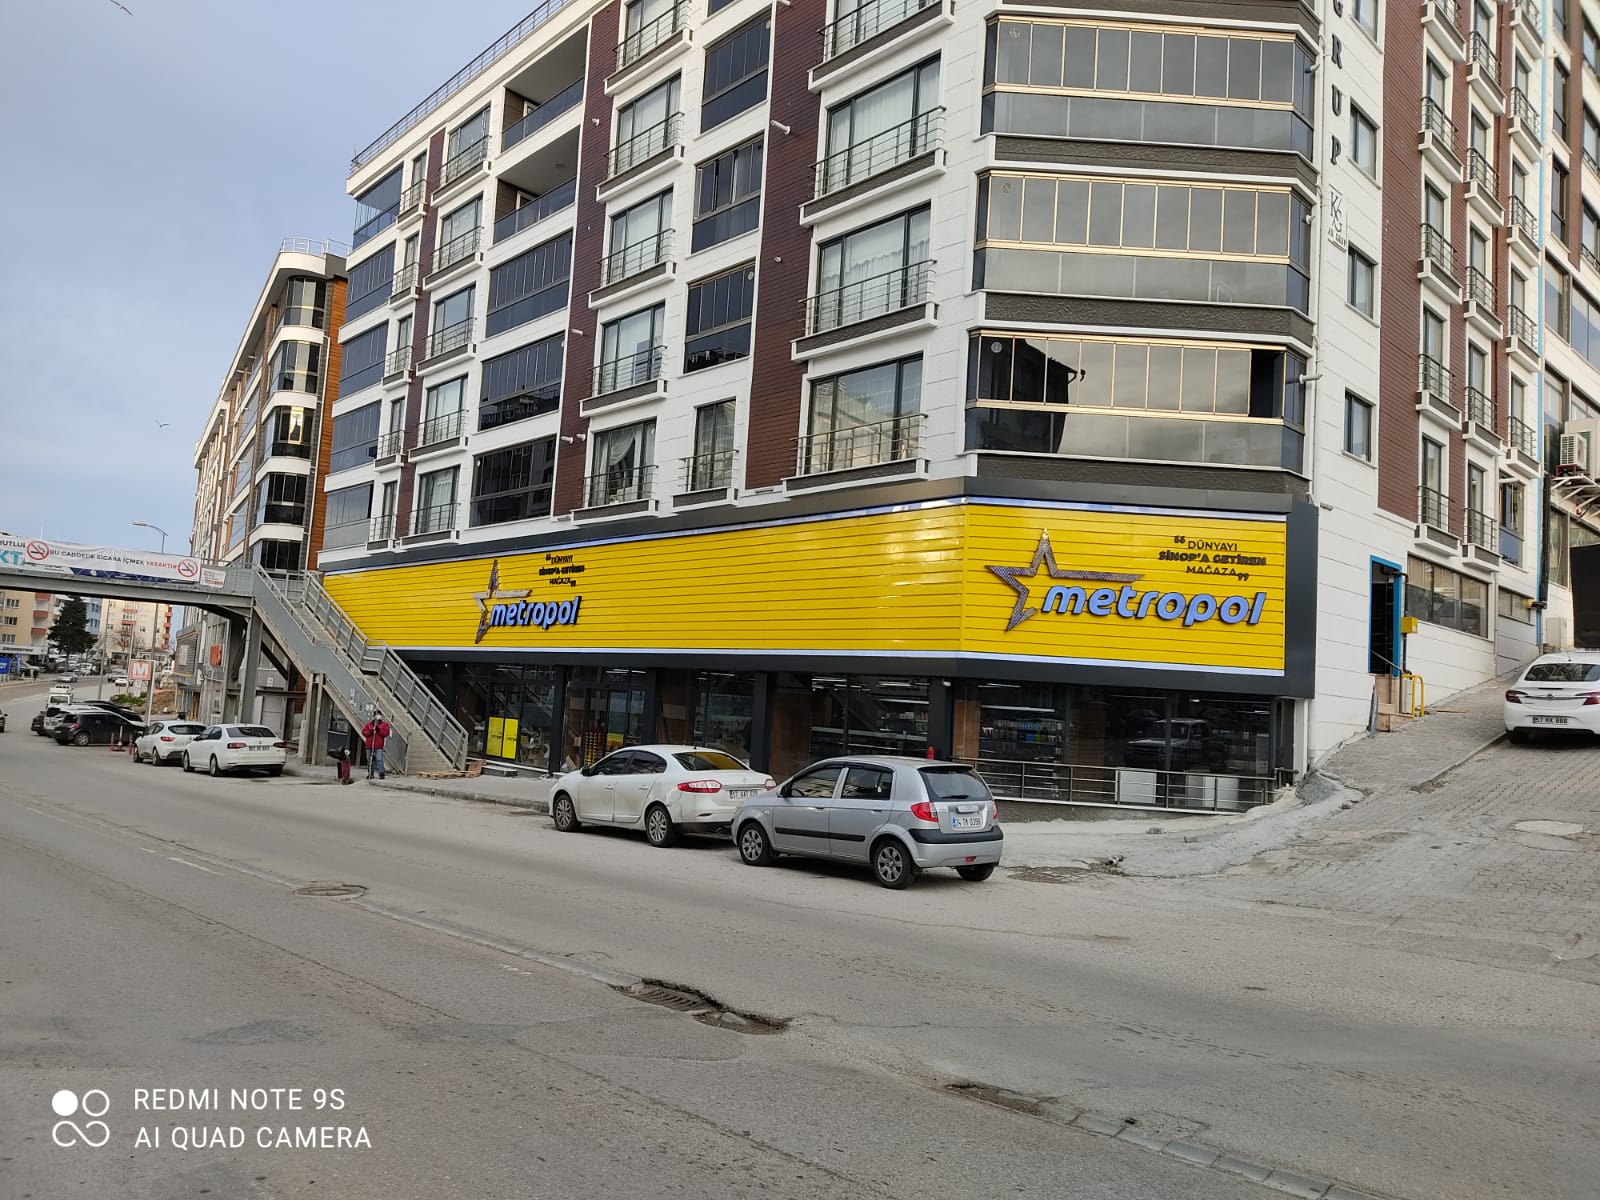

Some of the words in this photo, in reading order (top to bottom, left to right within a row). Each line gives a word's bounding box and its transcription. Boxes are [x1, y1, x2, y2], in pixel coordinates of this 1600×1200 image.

[1212, 553, 1267, 566] GETİREN
[489, 596, 582, 630] metropol
[1041, 585, 1268, 627] metropol
